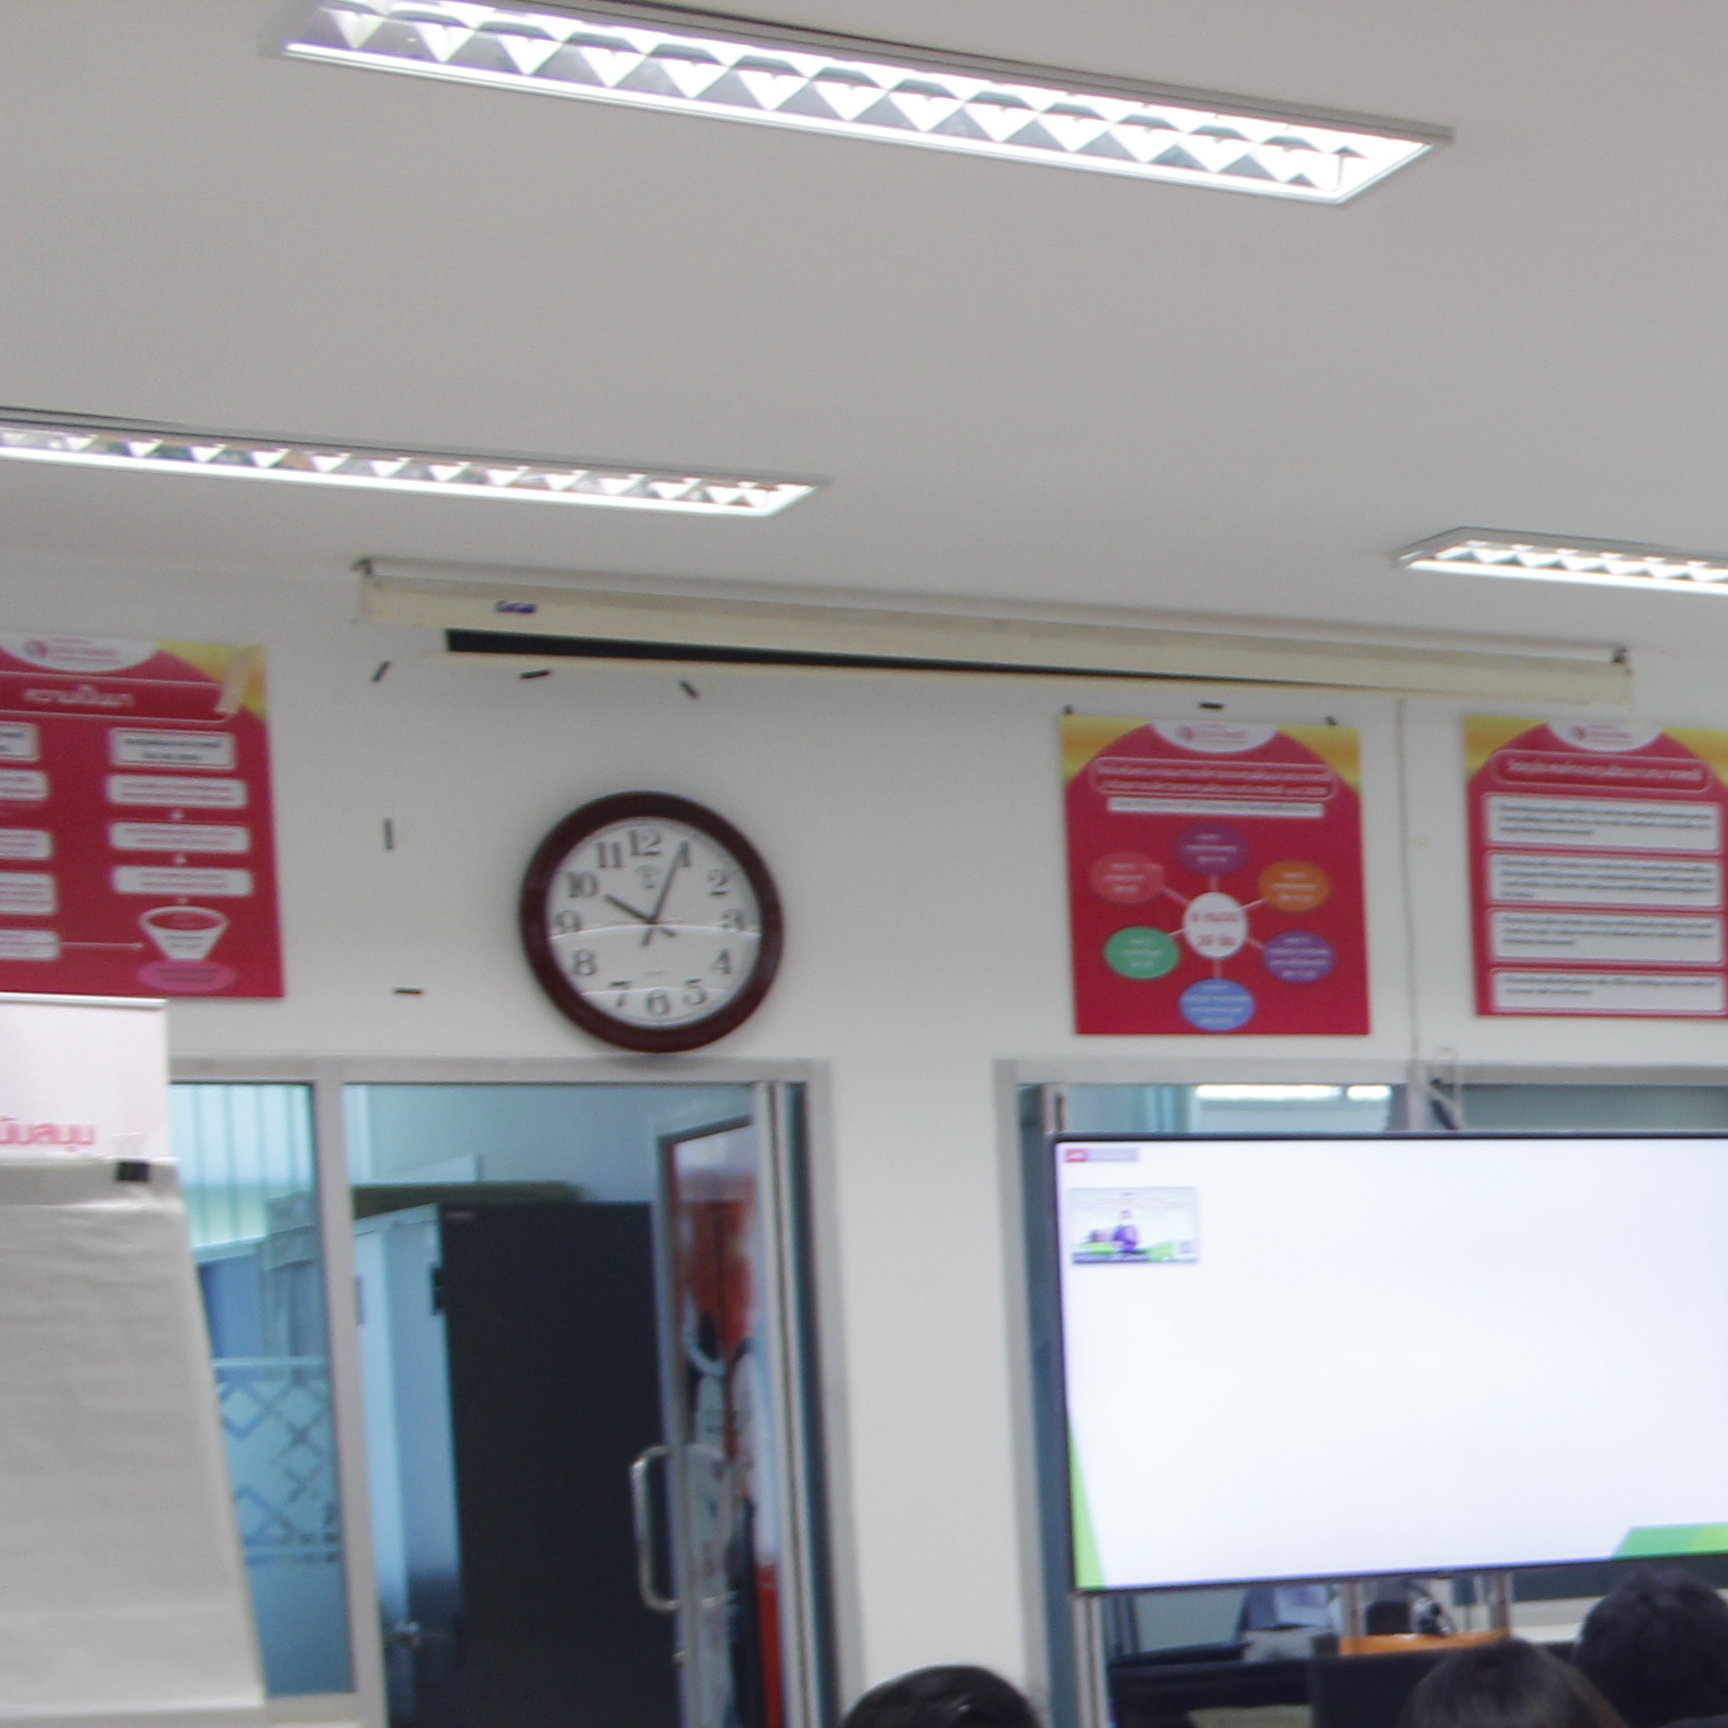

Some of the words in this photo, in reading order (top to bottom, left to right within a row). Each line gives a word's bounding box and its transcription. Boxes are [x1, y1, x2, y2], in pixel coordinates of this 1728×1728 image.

[596, 841, 623, 868] 11
[629, 829, 662, 856] 12
[565, 871, 598, 898] 10
[707, 869, 729, 895] 2
[554, 909, 582, 933] 9
[721, 908, 746, 931] 3
[572, 949, 597, 976] 8
[709, 949, 732, 975] 4
[609, 979, 632, 1007] 7
[645, 989, 671, 1016] 6
[682, 977, 708, 1006] 5
